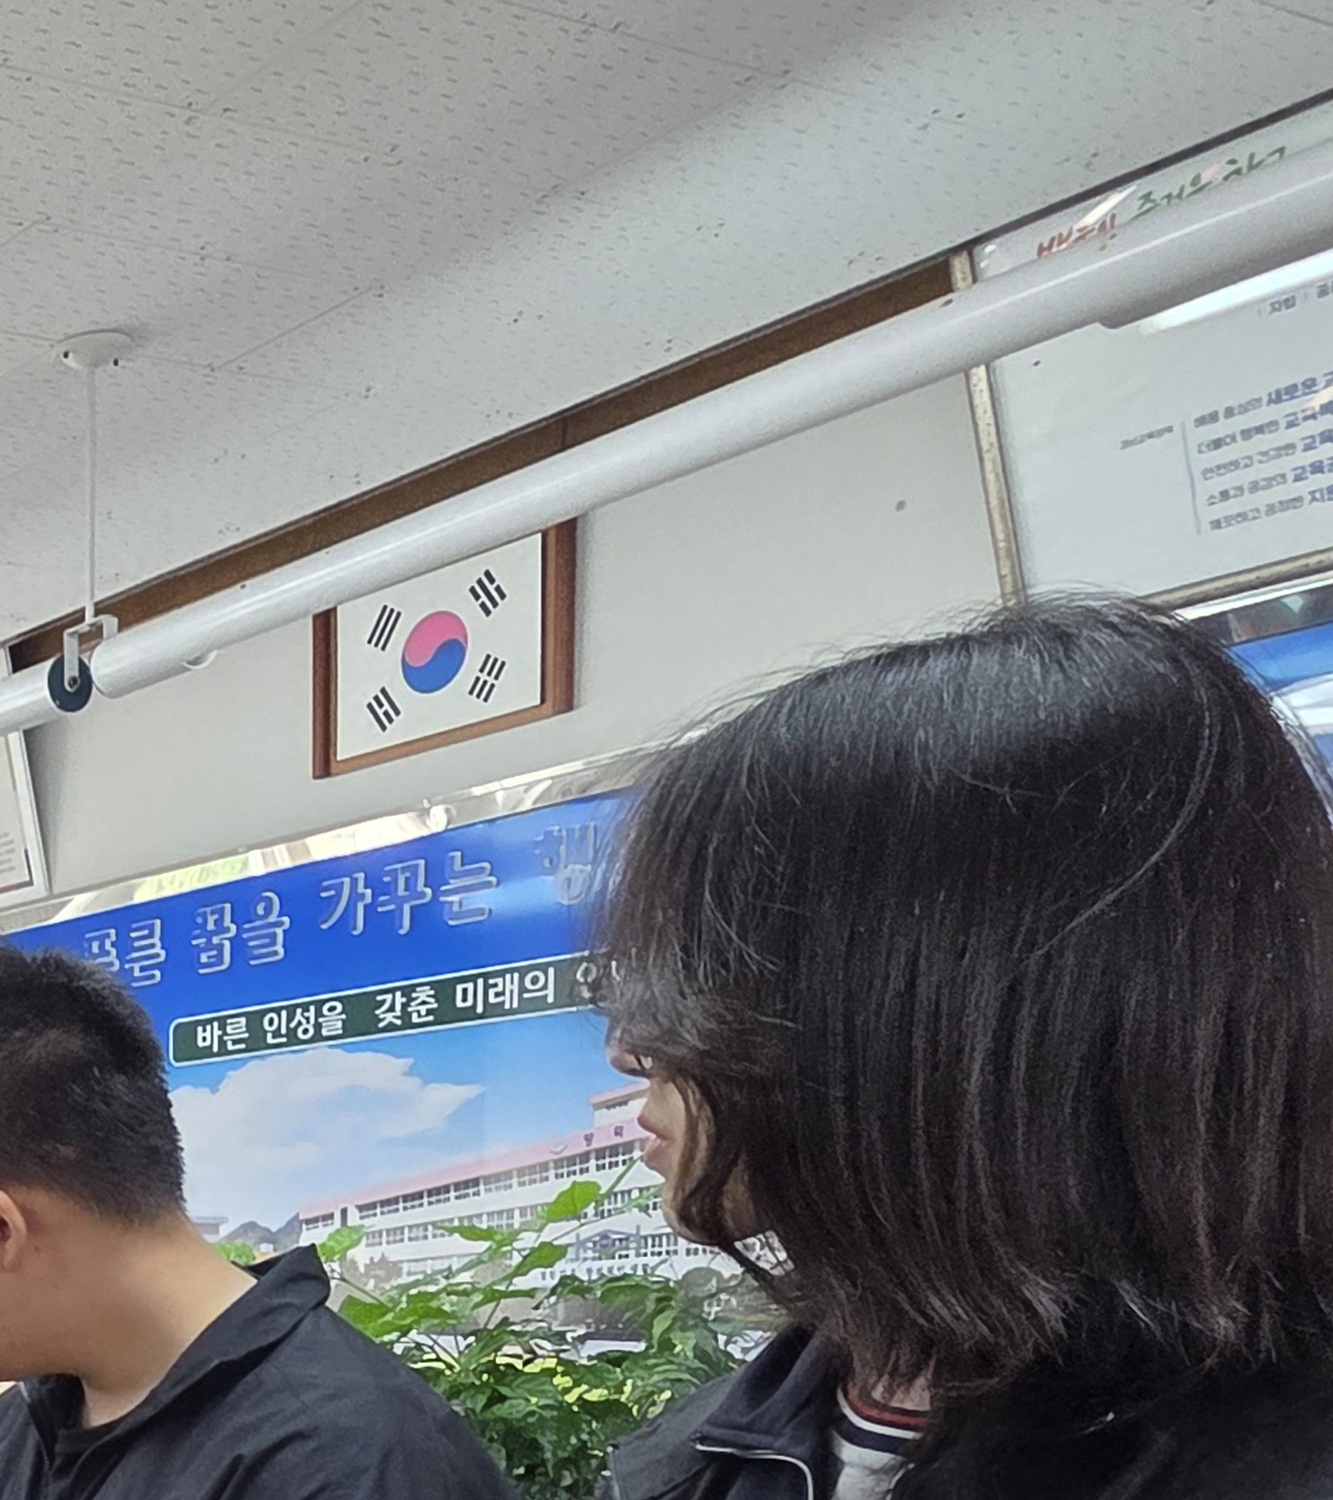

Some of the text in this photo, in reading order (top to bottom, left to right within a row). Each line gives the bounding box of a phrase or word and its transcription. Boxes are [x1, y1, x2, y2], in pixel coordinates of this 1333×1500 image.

[191, 891, 290, 974] 꿈을
[319, 850, 497, 936] 가꾸는
[196, 1017, 249, 1053] 바른
[263, 1001, 346, 1044] 인성을
[374, 985, 439, 1029] 갖춘
[455, 966, 555, 1014] 미래의
